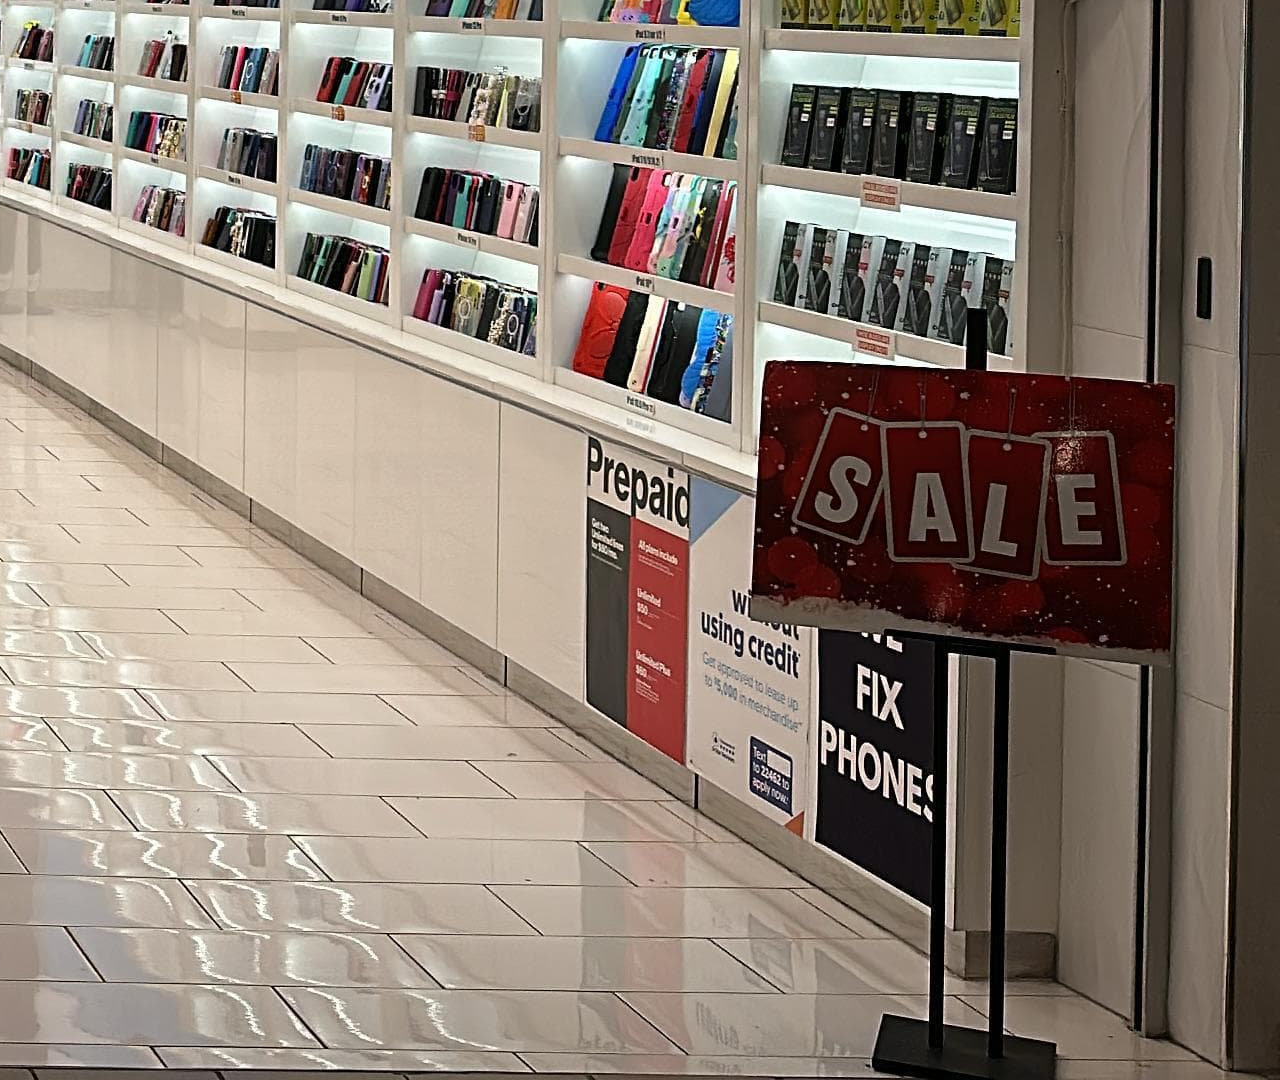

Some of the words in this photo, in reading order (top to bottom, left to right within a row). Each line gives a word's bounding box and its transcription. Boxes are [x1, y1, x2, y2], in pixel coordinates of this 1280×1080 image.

[587, 435, 691, 529] Prepaid
[813, 455, 1104, 558] SALE
[701, 611, 745, 658] using
[702, 651, 717, 669] Get
[717, 660, 755, 689] approved
[754, 680, 764, 695] to
[764, 683, 787, 705] lease
[787, 694, 800, 712] up
[856, 663, 905, 731] FIX
[752, 745, 768, 764] Text
[752, 761, 761, 777] to
[760, 763, 782, 786] 22462
[781, 775, 790, 791] to
[751, 777, 772, 798] apply
